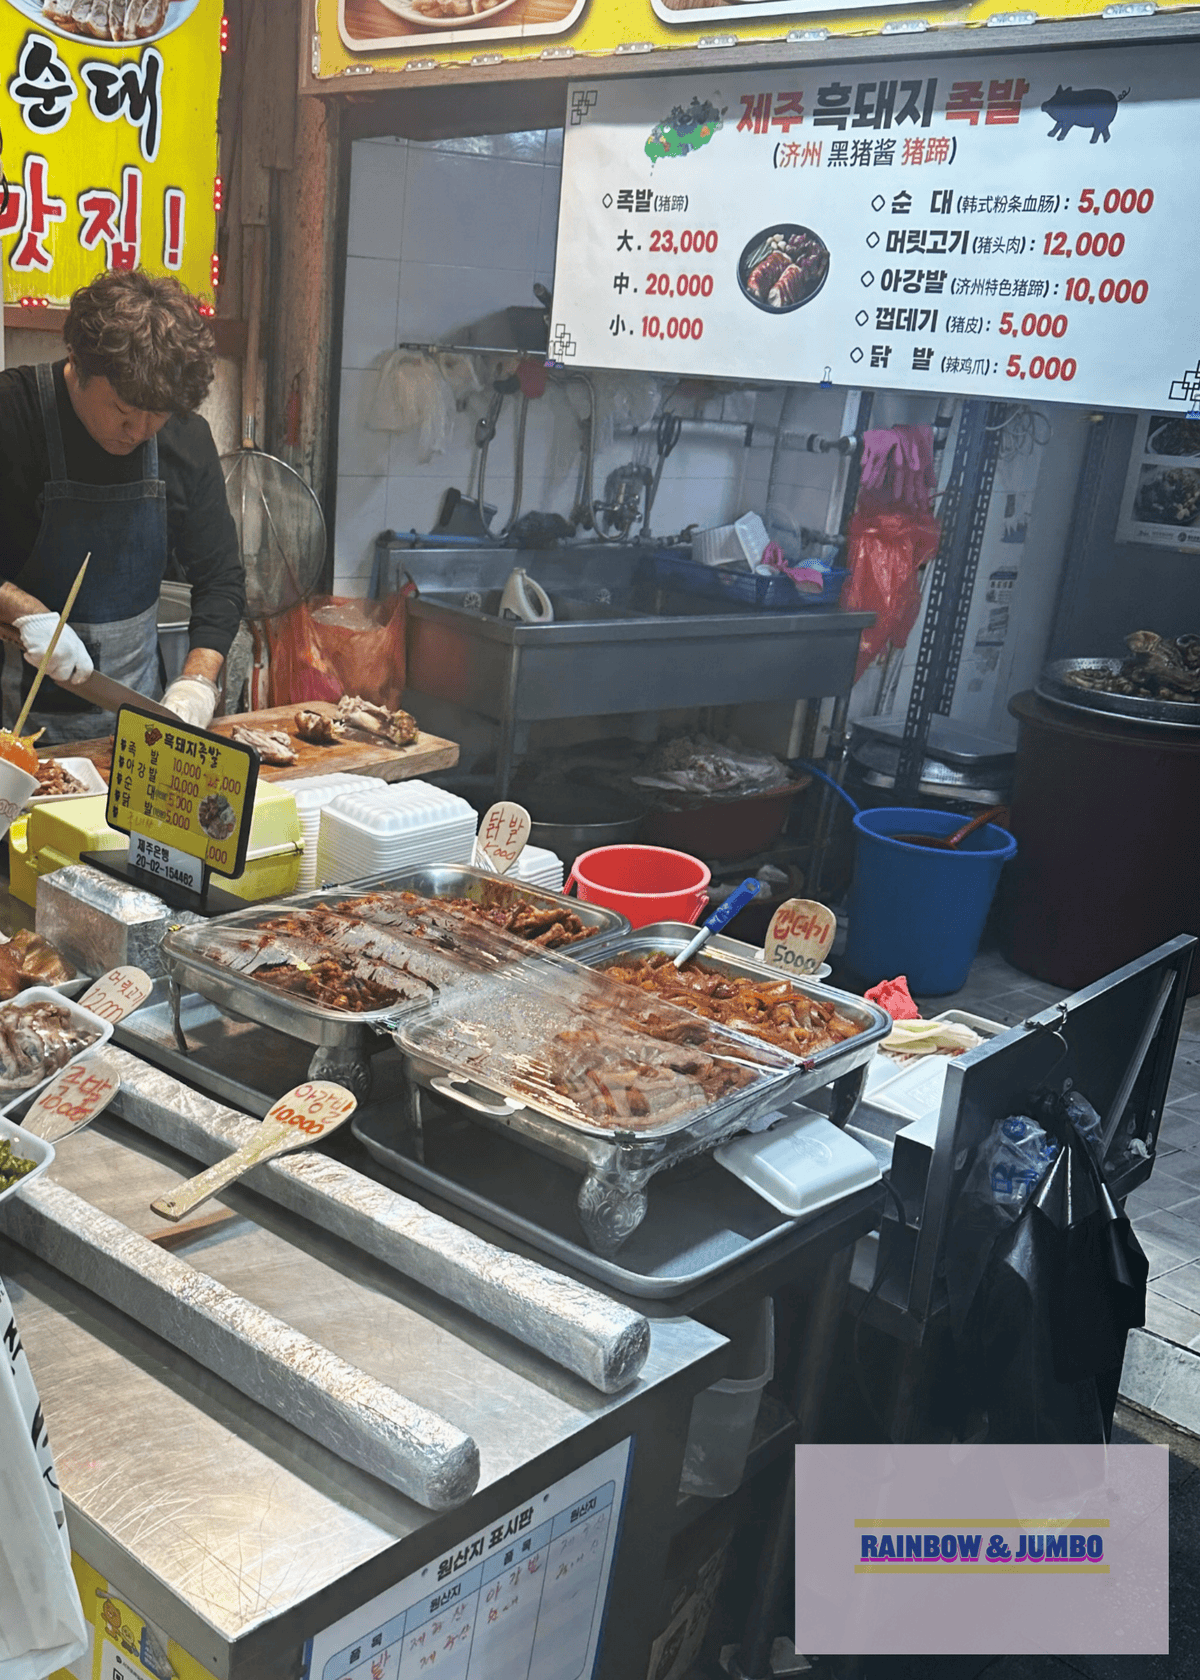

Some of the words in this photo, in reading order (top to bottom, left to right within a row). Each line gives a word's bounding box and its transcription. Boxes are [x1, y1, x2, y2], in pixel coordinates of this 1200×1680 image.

[736, 91, 804, 135] 제주
[813, 78, 938, 131] 흑돼지
[945, 78, 1030, 127] 족발
[827, 138, 896, 168] 黑猪酱
[1078, 189, 1154, 216] 5,000
[650, 230, 718, 254] 23,000
[1043, 232, 1125, 258] 12,000
[645, 273, 714, 298] 20,000
[1065, 277, 1149, 304] 10,000
[642, 316, 704, 341] 10,000
[875, 307, 939, 333] 껍데기
[998, 312, 1068, 338] 5,000
[1006, 354, 1077, 381] 5,000
[173, 757, 202, 780] 10,000
[170, 775, 199, 798] 10,000
[486, 807, 525, 845] 닭발
[137, 838, 170, 863] 제주은행
[135, 853, 194, 888] 20-02-154462
[773, 944, 816, 970] 5000
[570, 1496, 598, 1523] 원산지
[437, 1536, 485, 1582] 원산지
[488, 1506, 534, 1549] 표시판
[429, 1583, 461, 1614] 원산지
